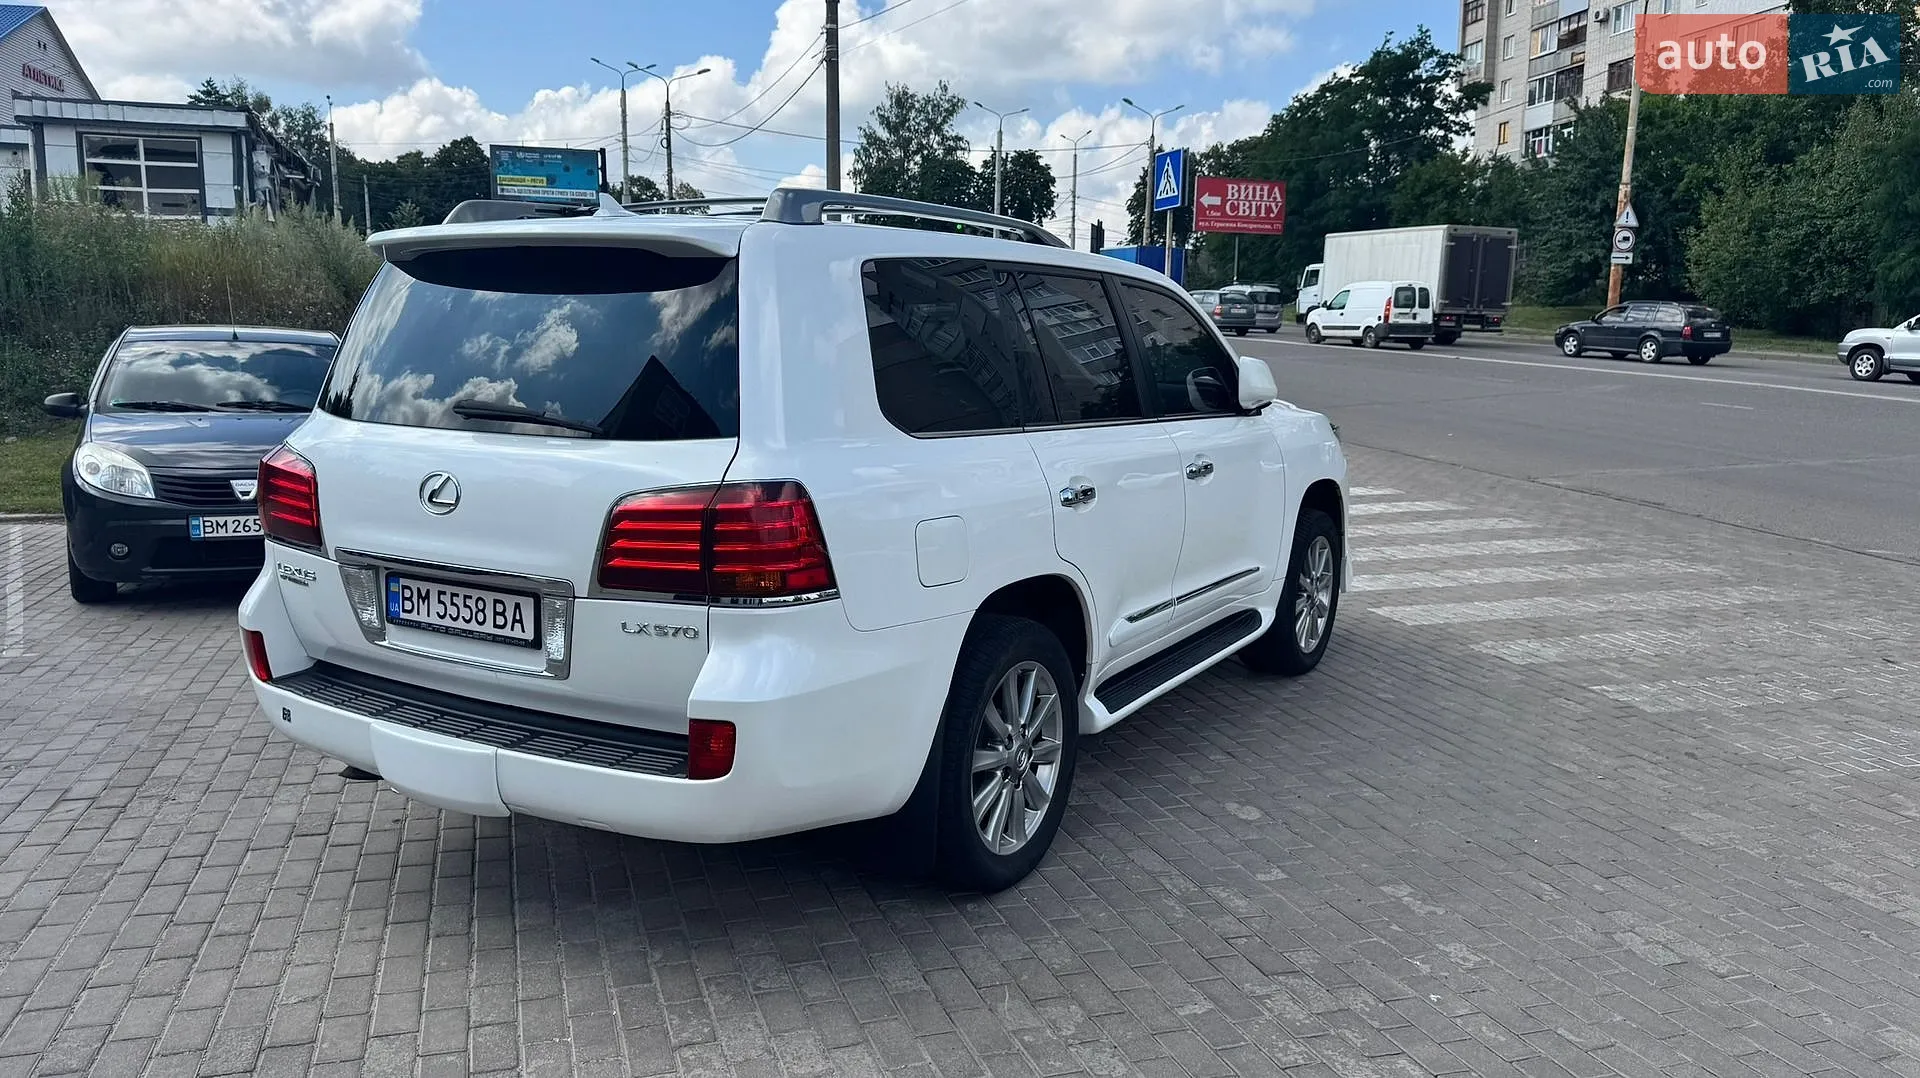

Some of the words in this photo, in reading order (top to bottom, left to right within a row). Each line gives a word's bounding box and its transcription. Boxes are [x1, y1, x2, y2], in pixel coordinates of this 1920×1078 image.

[22, 63, 65, 92] АТЛЕТИКА
[1226, 183, 1282, 201] ВИНА
[1225, 200, 1282, 218] СВІТУ
[203, 520, 228, 534] BM
[277, 561, 316, 581] LEXUS
[389, 602, 399, 612] UA
[401, 584, 431, 618] BM
[436, 590, 487, 626] 5558
[493, 599, 526, 633] BA
[420, 622, 446, 632] AUTO
[448, 627, 493, 641] GALLERY
[621, 621, 650, 636] LX
[653, 624, 699, 639] 570
